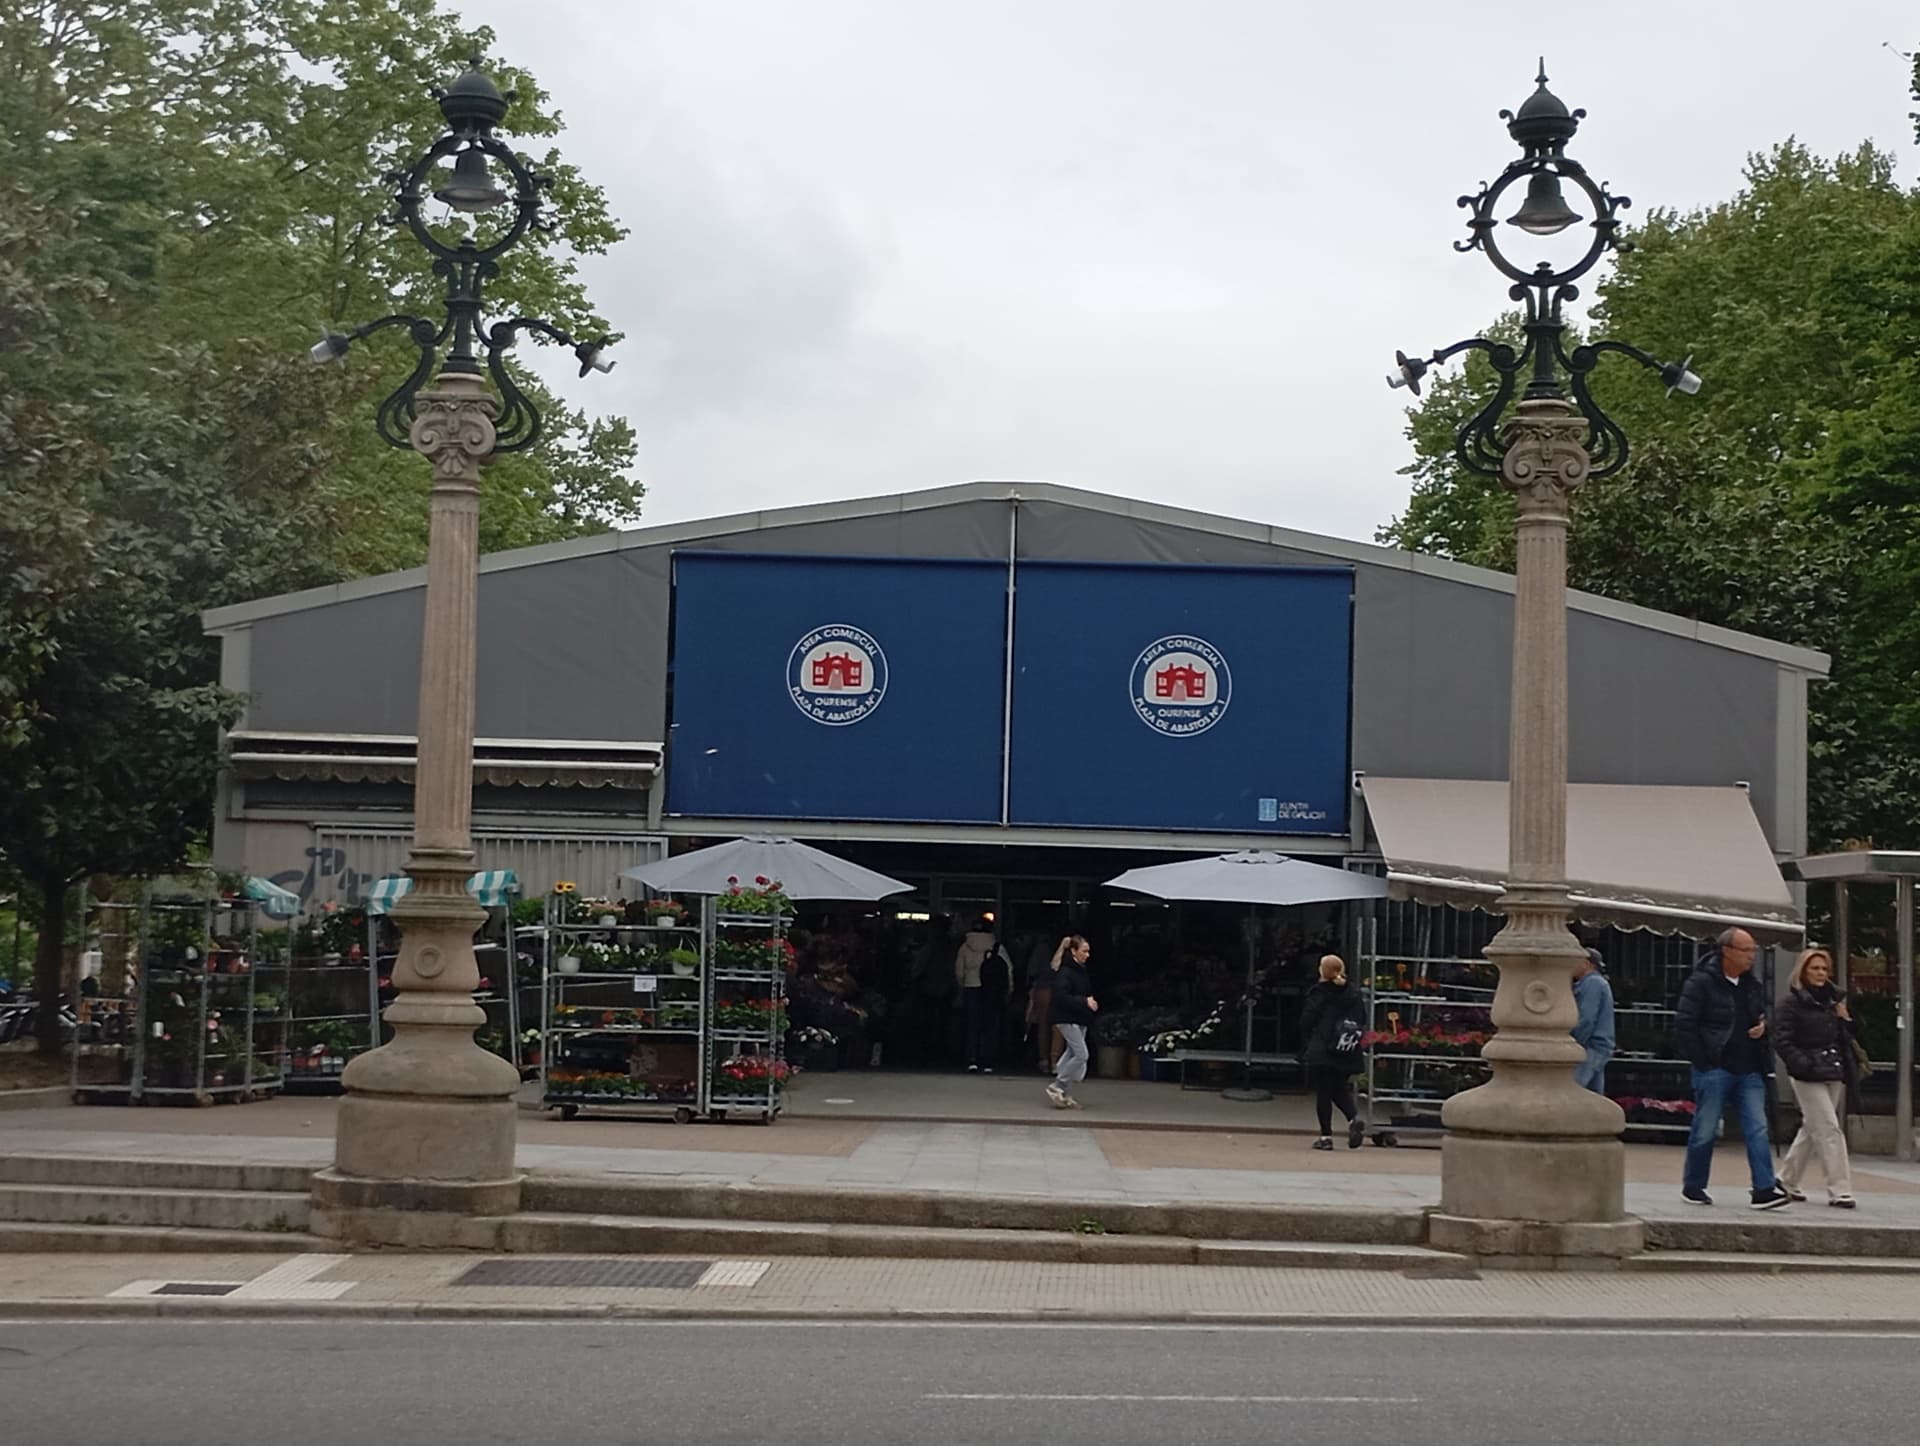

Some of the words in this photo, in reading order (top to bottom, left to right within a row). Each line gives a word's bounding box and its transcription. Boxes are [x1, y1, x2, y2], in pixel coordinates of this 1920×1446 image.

[823, 628, 877, 657] COMERCIAL
[1166, 640, 1221, 668] COMERCIAL
[792, 686, 812, 711] PLAZA
[812, 708, 826, 719] DE
[826, 705, 867, 721] ABASTOS
[815, 697, 858, 707] OURENSE
[1136, 697, 1155, 723] PLAZA
[1155, 719, 1170, 730] DE
[1170, 716, 1211, 732] ABASTOS
[1158, 708, 1201, 718] OURENSE
